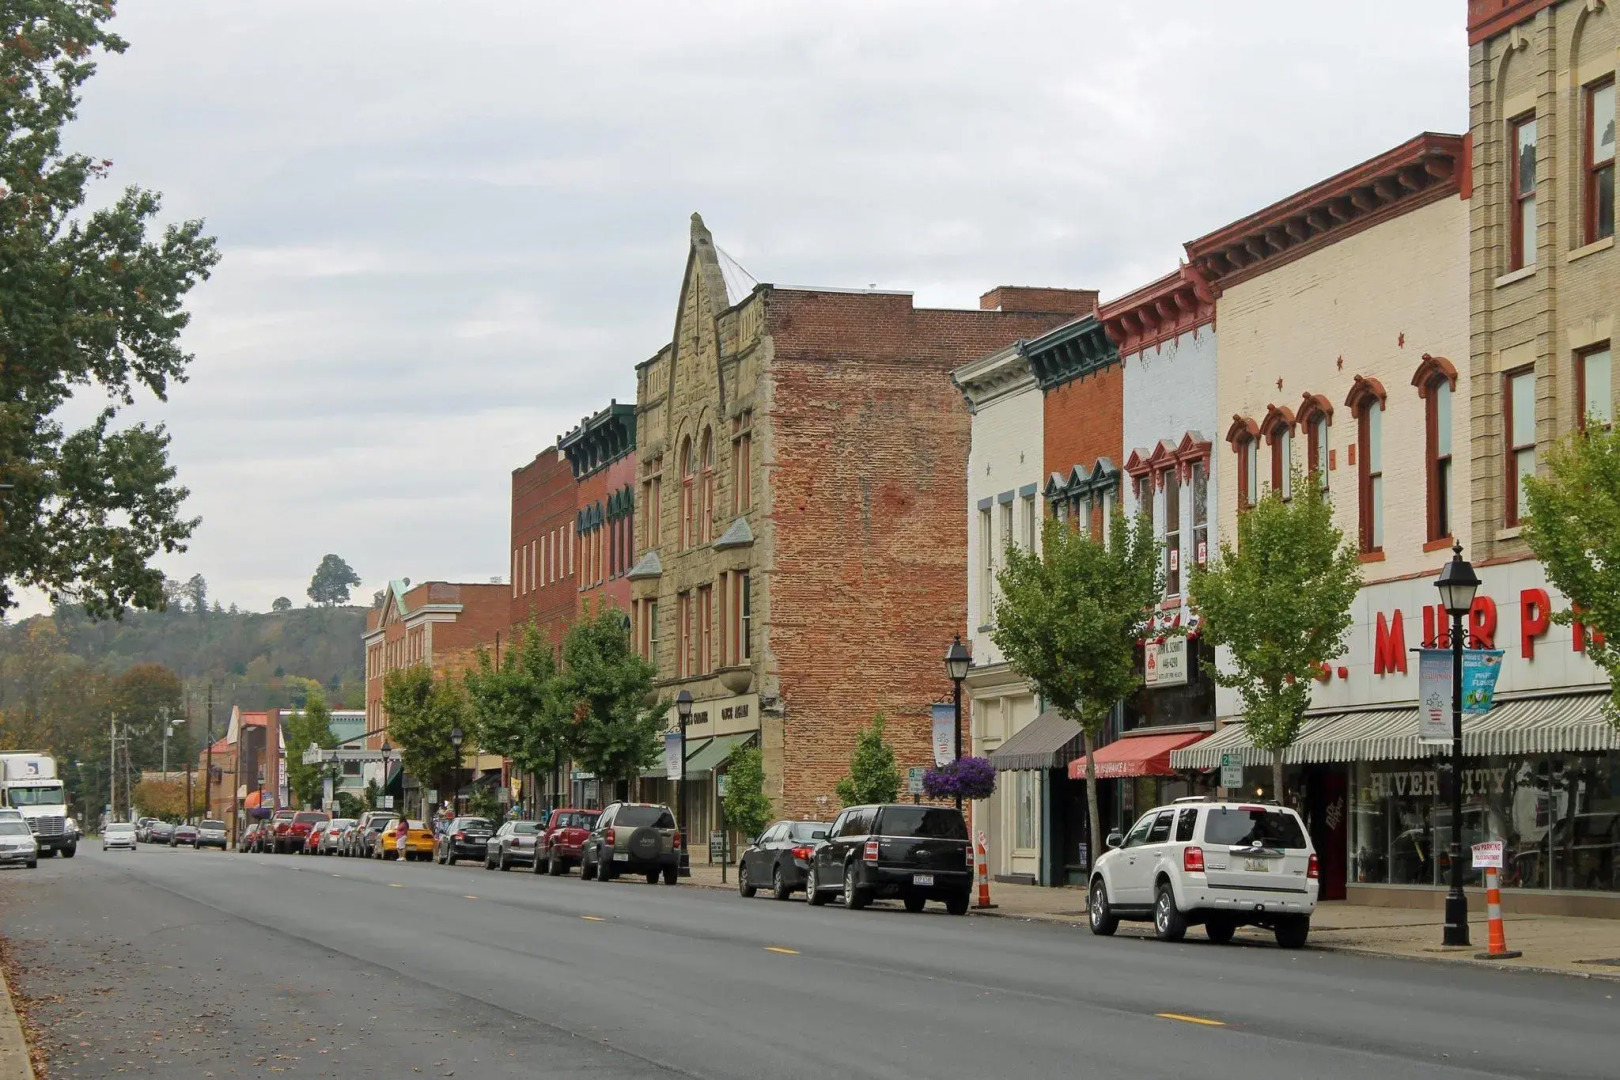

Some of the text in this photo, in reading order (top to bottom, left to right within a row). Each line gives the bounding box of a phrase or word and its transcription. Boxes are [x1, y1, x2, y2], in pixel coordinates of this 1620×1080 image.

[1370, 768, 1508, 797] RIVER ITY
[1481, 843, 1501, 851] PARKING
